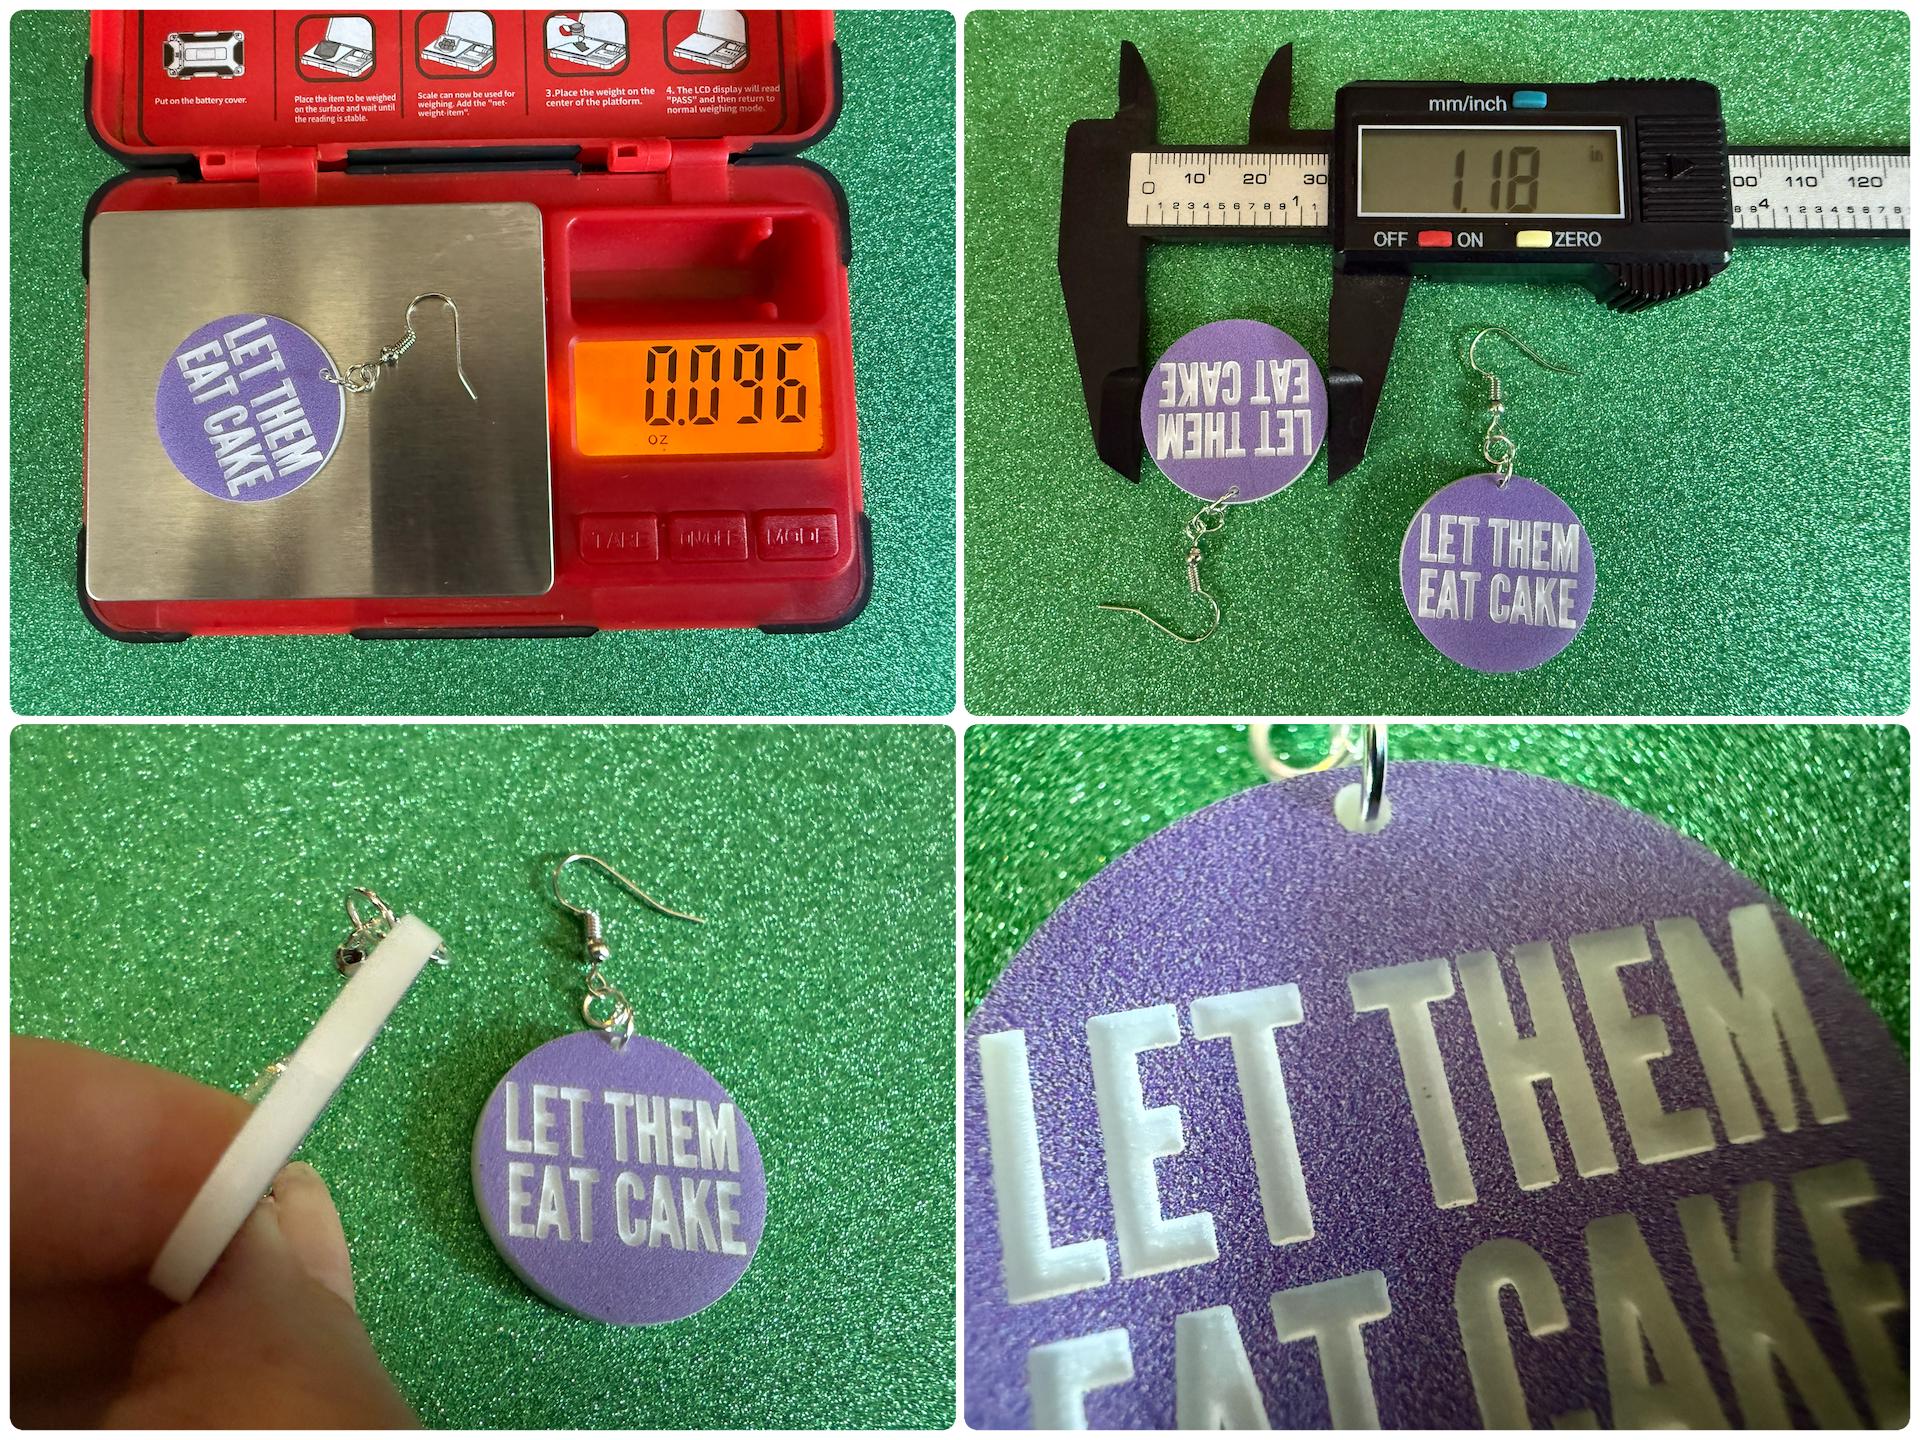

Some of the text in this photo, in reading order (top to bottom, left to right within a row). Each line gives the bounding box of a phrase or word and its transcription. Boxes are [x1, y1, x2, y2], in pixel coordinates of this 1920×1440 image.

[417, 91, 438, 99] Scale
[484, 90, 502, 98] used
[504, 89, 515, 97] for
[545, 87, 655, 97] 3.Place the weight on the
[665, 84, 780, 94] 4. The LCD display will read
[154, 97, 168, 105] Put
[195, 96, 223, 106] battery
[294, 92, 397, 103] Place the item to be weighed
[417, 100, 455, 109] weighing.
[473, 99, 486, 107] the
[545, 97, 643, 107] center of the platform.
[666, 95, 697, 104] "PASS"
[699, 95, 715, 103] and
[717, 94, 736, 103] then
[738, 95, 764, 103] return
[1429, 95, 1507, 112] mm/inch
[305, 105, 317, 113] the
[319, 104, 345, 113] surface
[346, 104, 360, 112] and
[360, 103, 377, 112] wait
[378, 103, 396, 111] until
[666, 103, 765, 114] normal weighing mode.
[294, 114, 368, 124] the reading is stable.
[1184, 173, 1328, 185] 10 20 30
[1452, 146, 1540, 213] 1.18
[1732, 176, 1883, 188] 00 110 120
[1142, 181, 1155, 194] 0
[1218, 202, 1226, 210] 5
[1233, 202, 1241, 210] 6
[1248, 202, 1255, 210] 7
[1263, 202, 1271, 210] 8
[1292, 195, 1299, 206] 1
[1758, 198, 1769, 208] 4
[1373, 231, 1602, 248] OFF ON ZERO
[644, 343, 807, 426] 0.096
[1159, 358, 1309, 408] EAT CAKE
[223, 317, 323, 477] LET THEM
[176, 340, 274, 497] EAT CAKE
[1156, 409, 1313, 461] LET THEM
[591, 531, 649, 549] TARE
[767, 528, 833, 545] MODE
[1419, 513, 1580, 573] LET THEM
[1418, 568, 1578, 629] EAT CAKE
[978, 902, 1851, 1306] LET THEM
[505, 1081, 740, 1173] LET THEM
[508, 1162, 747, 1256] EAT CAKE
